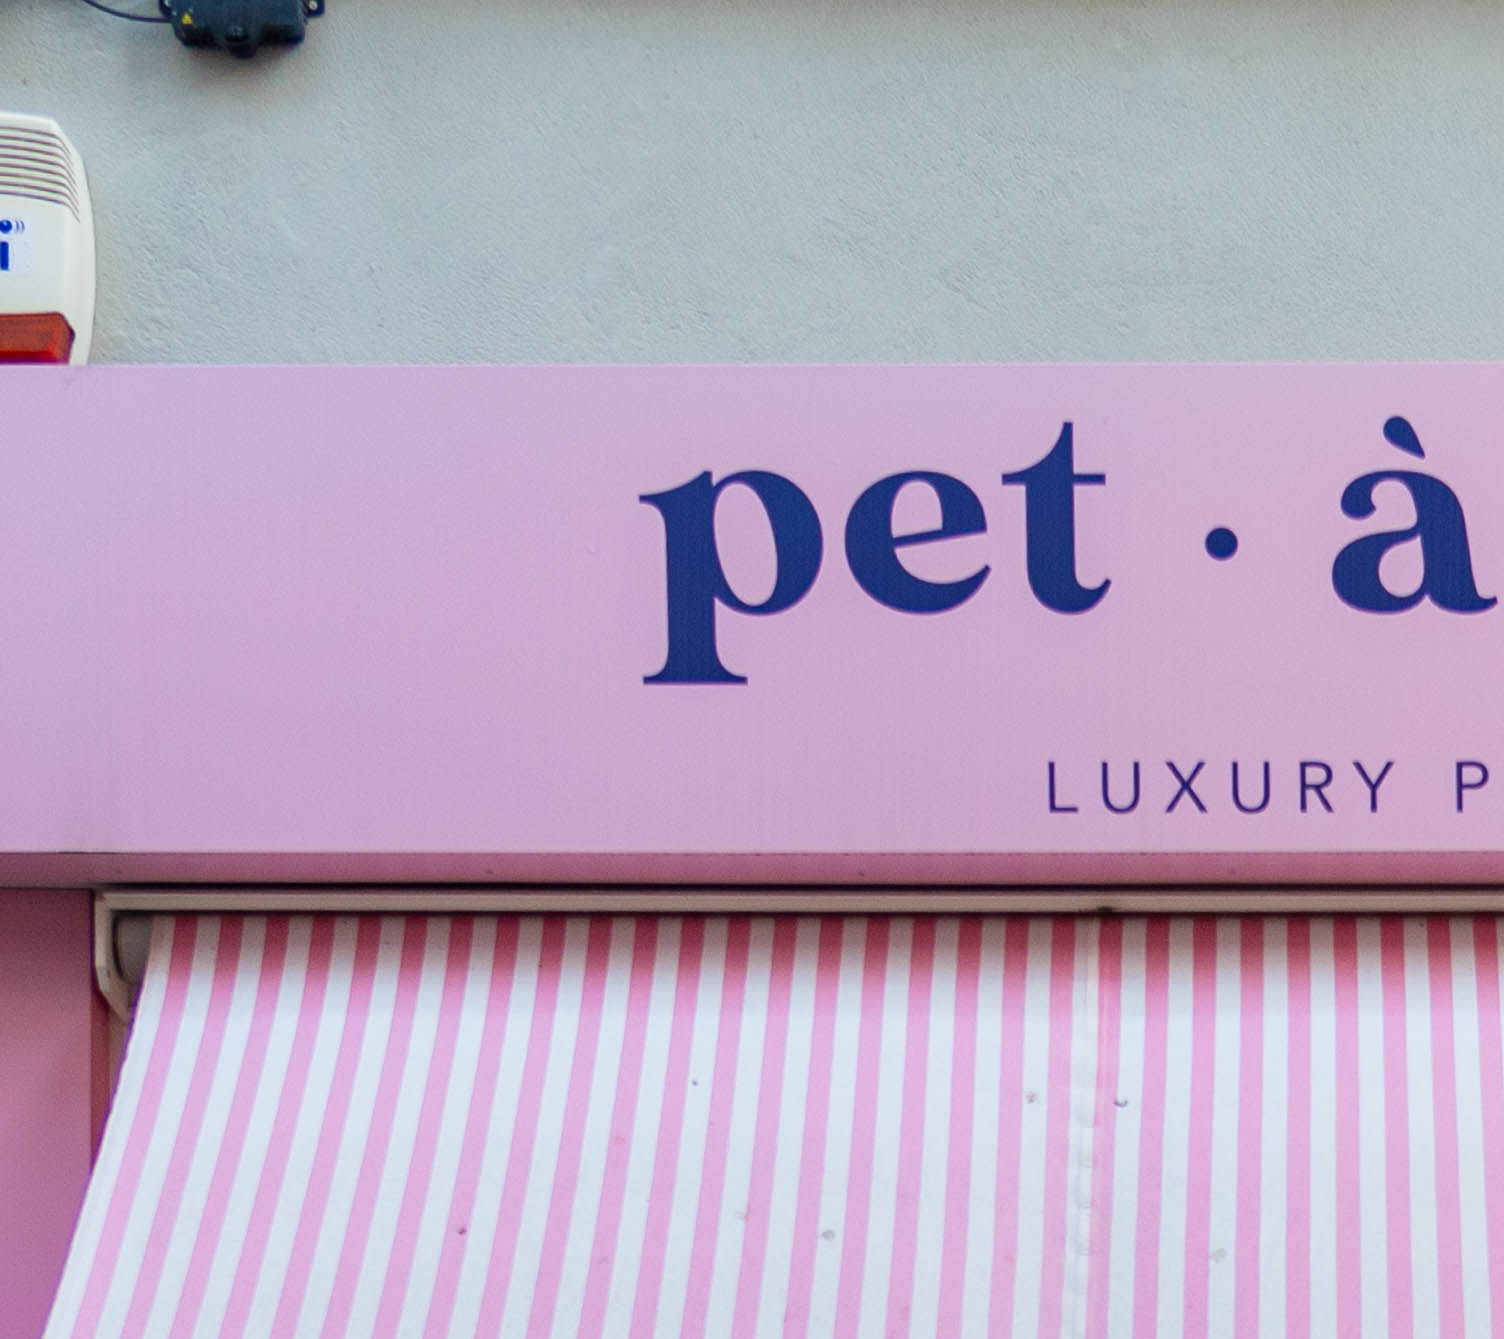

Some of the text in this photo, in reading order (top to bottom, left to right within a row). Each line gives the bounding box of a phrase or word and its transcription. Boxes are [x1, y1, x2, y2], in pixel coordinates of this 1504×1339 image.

[639, 421, 1113, 686] pet
[1332, 416, 1499, 616] à
[1047, 755, 1395, 816] LUXURY
